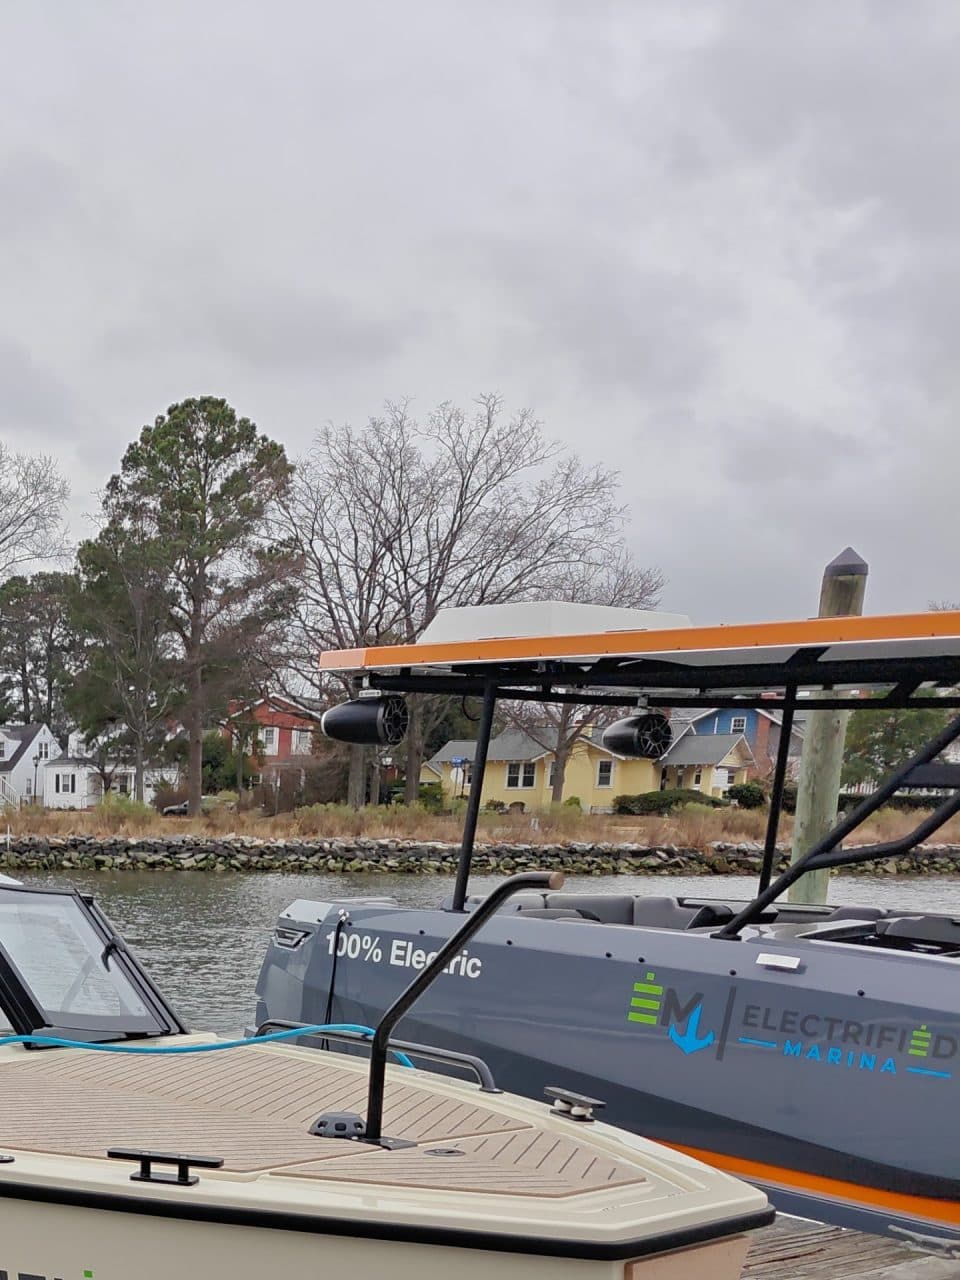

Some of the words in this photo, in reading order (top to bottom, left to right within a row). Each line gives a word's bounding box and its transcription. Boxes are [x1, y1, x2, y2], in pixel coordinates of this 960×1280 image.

[326, 930, 383, 963] 100%
[389, 939, 483, 979] Elecric
[742, 1003, 958, 1060] ELECTRIFIED
[783, 1039, 897, 1074] MARINA
